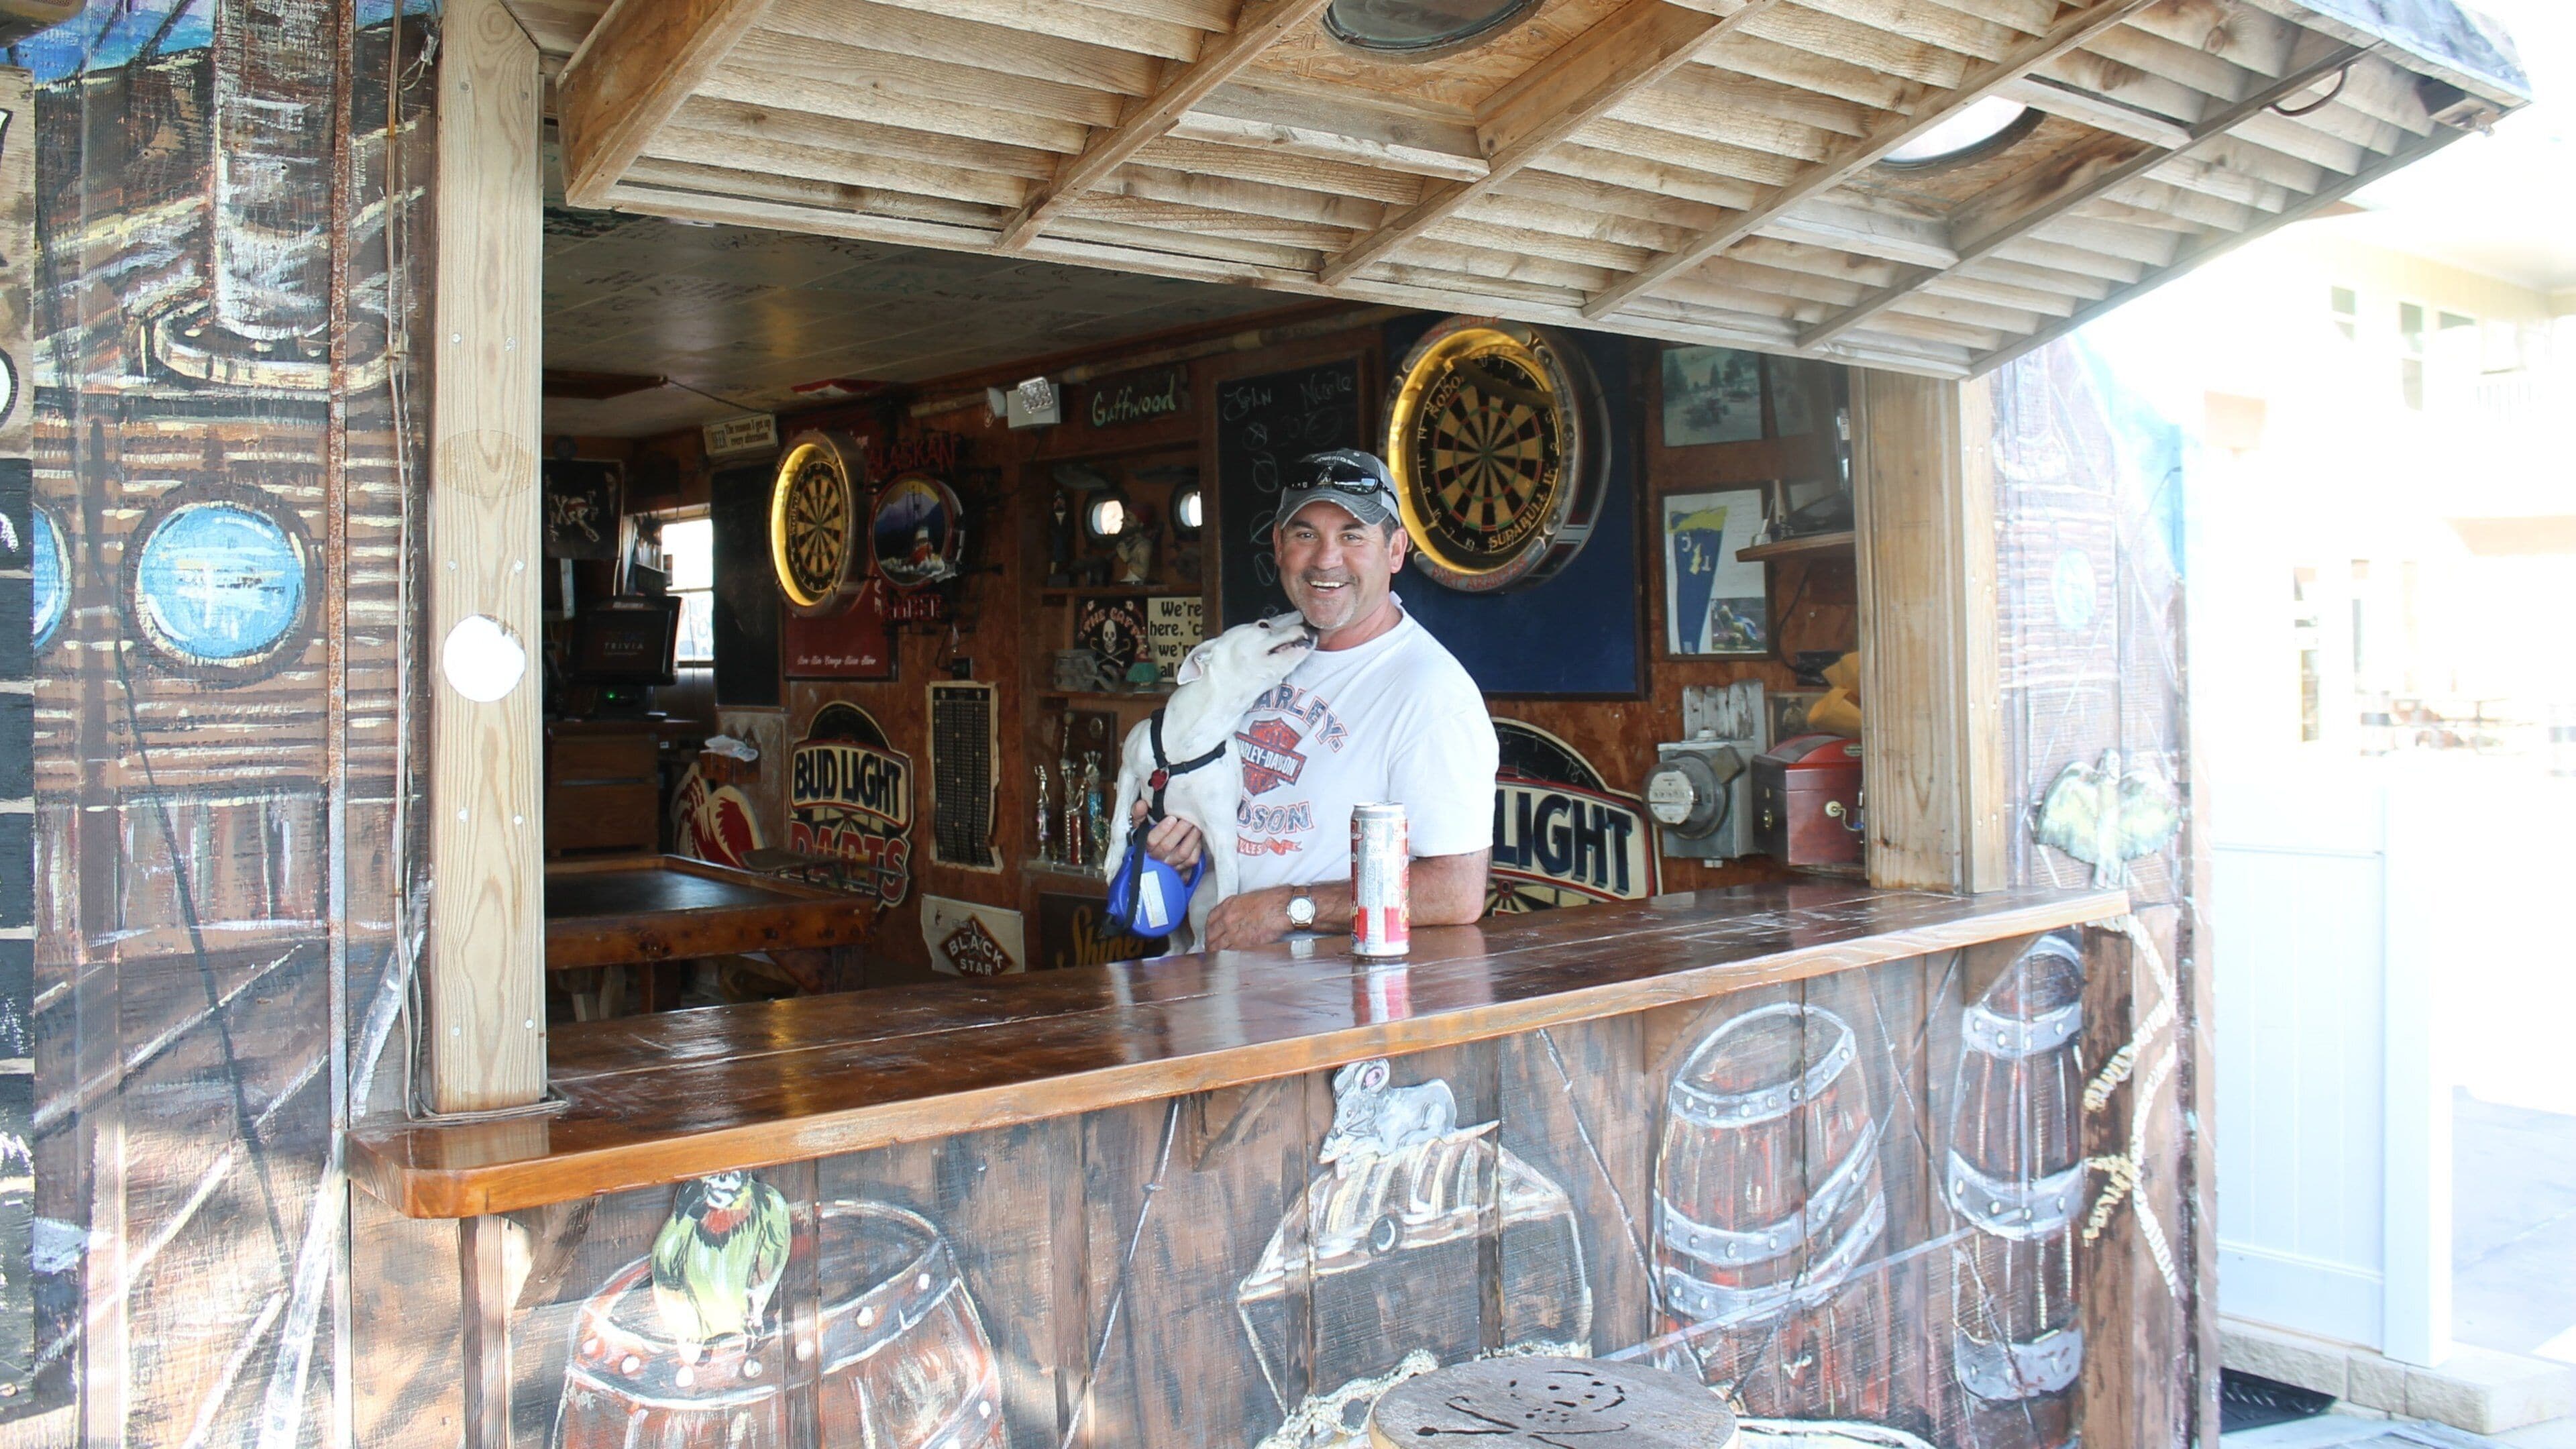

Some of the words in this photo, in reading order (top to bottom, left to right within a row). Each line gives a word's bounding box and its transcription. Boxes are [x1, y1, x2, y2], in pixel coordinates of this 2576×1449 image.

[869, 435, 955, 473] ALASKAN
[1161, 601, 1203, 617] We're
[604, 641, 645, 651] TRIVIA
[1161, 662, 1175, 678] all
[794, 749, 837, 801] BUD
[841, 749, 901, 818] LIGHT
[1493, 789, 1633, 896] LIGHT
[790, 820, 909, 902] DARTS
[948, 934, 1004, 970] BLACK
[959, 958, 993, 977] STAR
